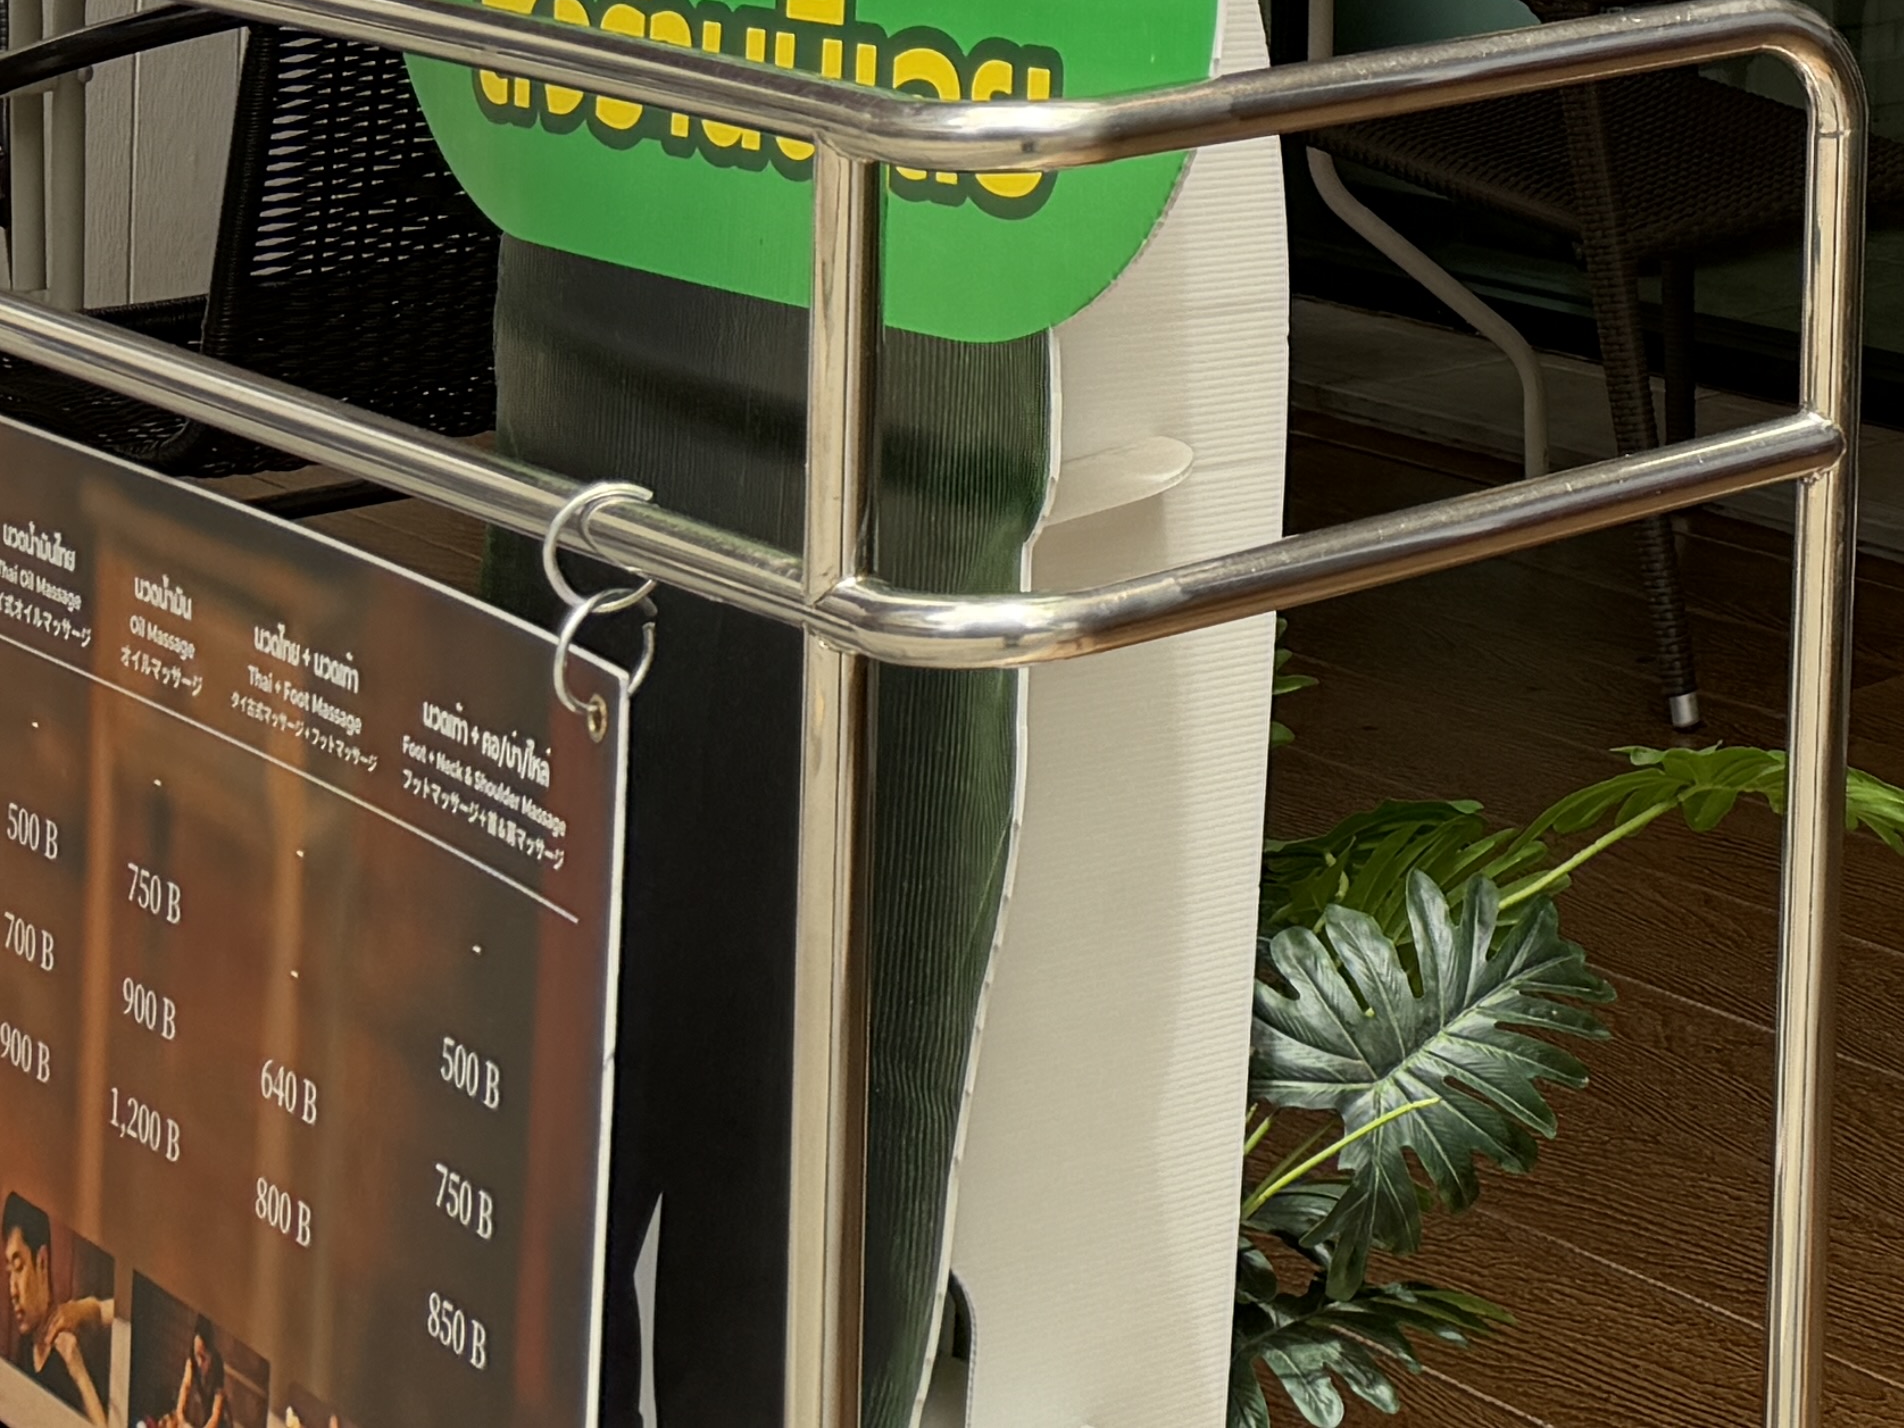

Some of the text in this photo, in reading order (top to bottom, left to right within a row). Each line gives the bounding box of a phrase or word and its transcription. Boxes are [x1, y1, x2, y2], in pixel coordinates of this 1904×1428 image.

[20, 569, 34, 591] Oil
[36, 575, 82, 612] Massage
[135, 574, 192, 621] นวดน้ำมัน
[130, 615, 195, 661] Oil Massage
[254, 622, 300, 666] นวดไทย
[248, 664, 362, 736] Thai Foot Massage
[402, 735, 566, 837] Foot Neck Shoulder Massage
[7, 803, 58, 859] 500 B
[127, 862, 181, 924] 750 B
[4, 911, 54, 971] 700 B
[123, 977, 176, 1040] 900 B
[0, 1022, 50, 1083] 900 B
[440, 1037, 499, 1109] 500 B
[261, 1059, 317, 1124] 640 B
[110, 1088, 180, 1162] 1,200 B
[255, 1177, 311, 1247] 800 B
[435, 1163, 492, 1240] 750 B
[428, 1292, 486, 1368] 850 B
